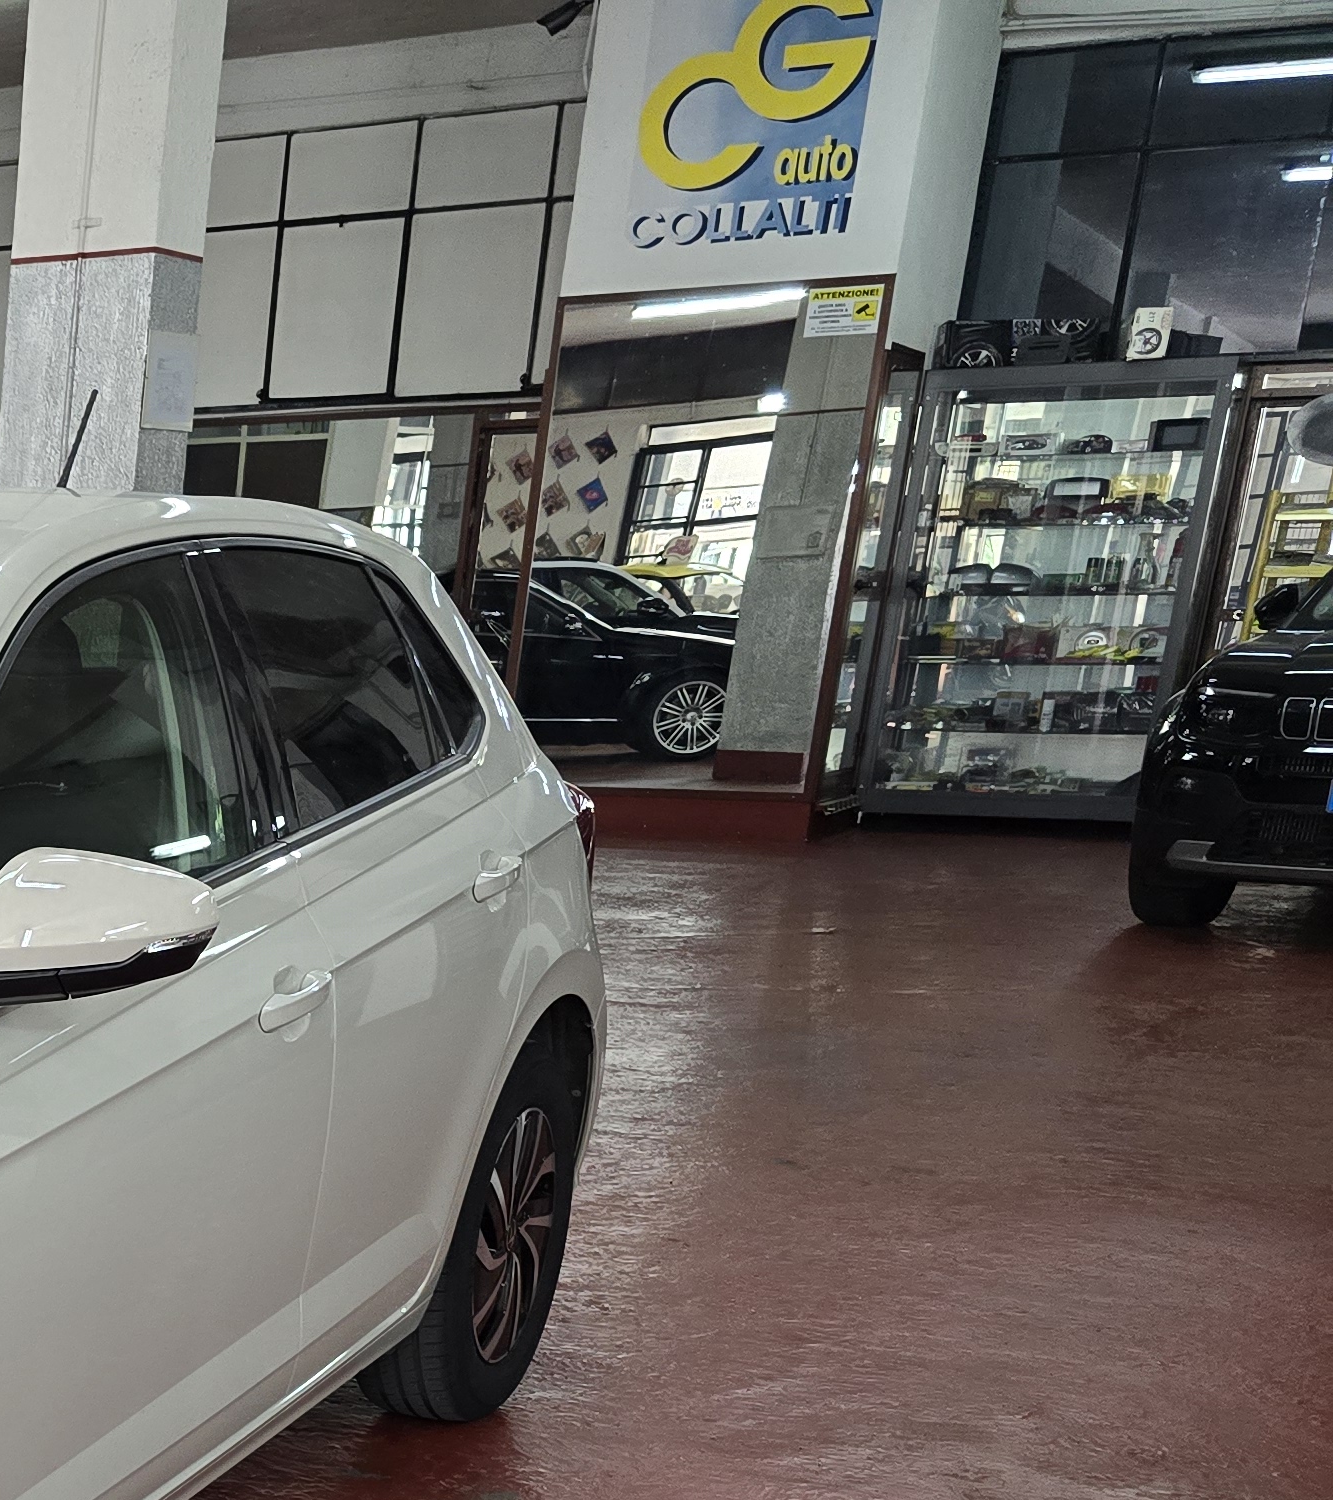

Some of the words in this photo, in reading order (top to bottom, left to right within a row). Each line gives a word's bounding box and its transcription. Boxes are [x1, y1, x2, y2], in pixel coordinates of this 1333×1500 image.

[774, 135, 858, 186] auto
[632, 193, 853, 249] COLLALTI
[813, 288, 879, 300] ATTENZIONE!
